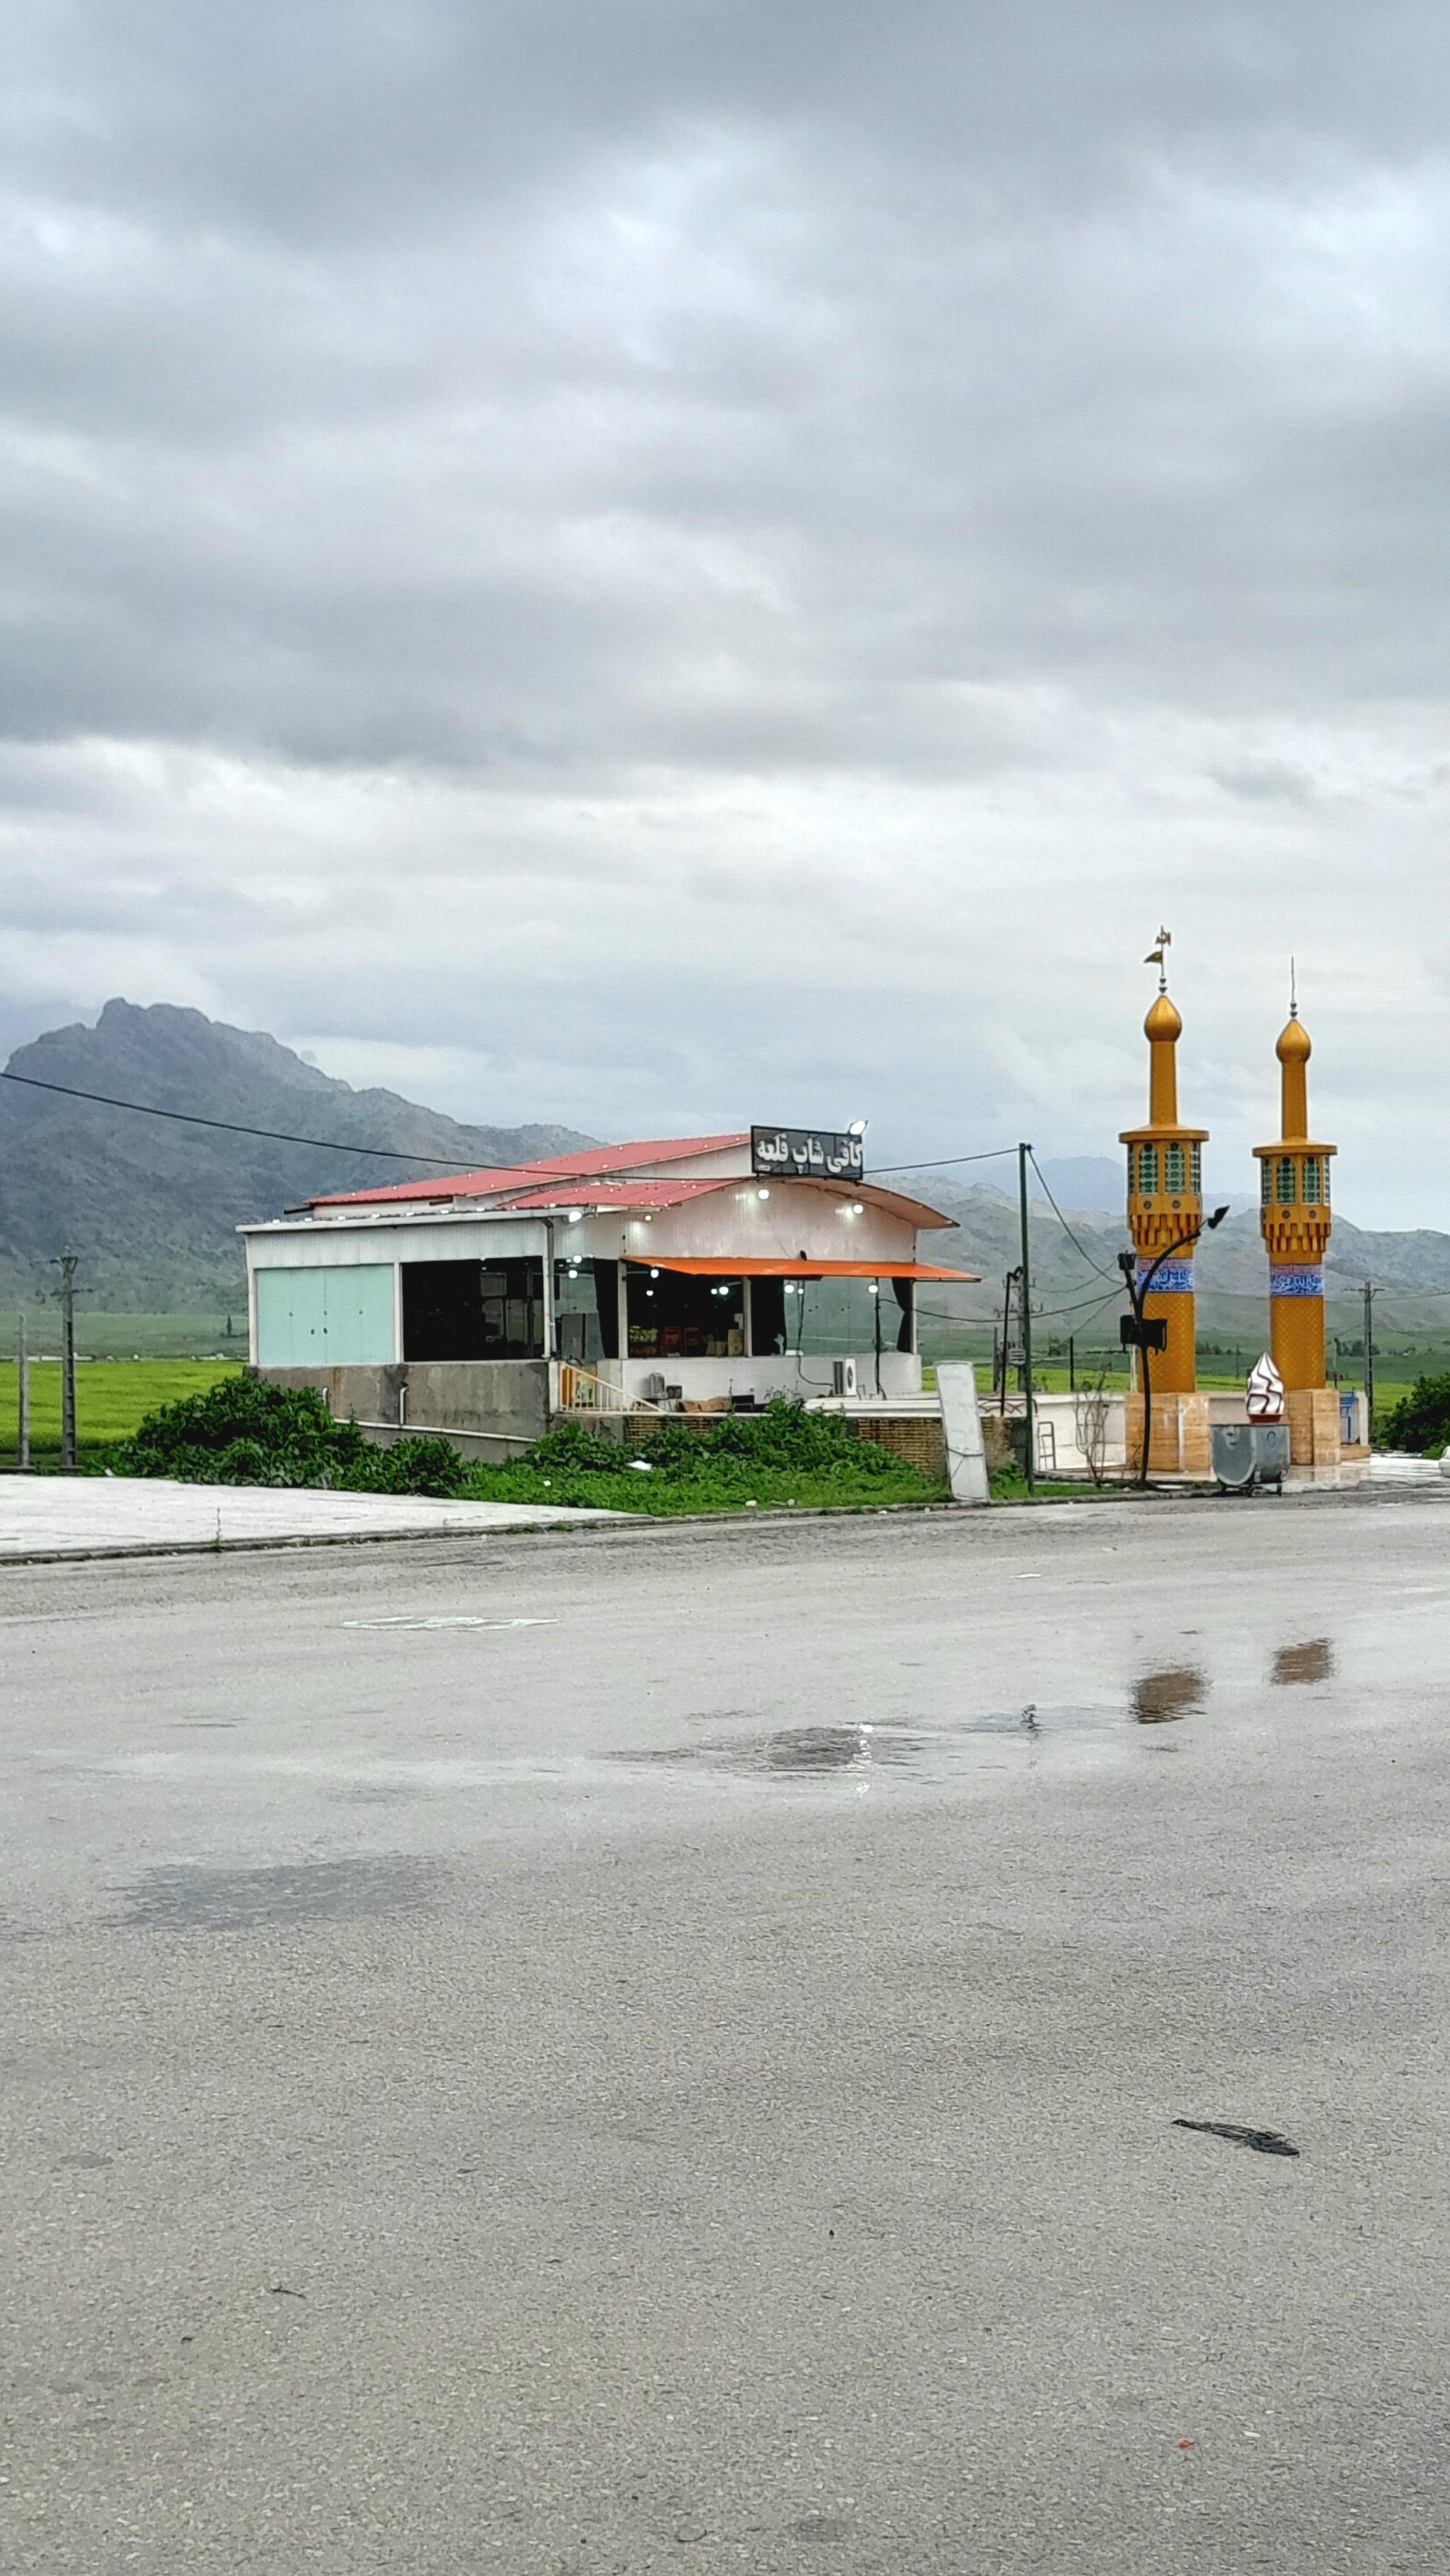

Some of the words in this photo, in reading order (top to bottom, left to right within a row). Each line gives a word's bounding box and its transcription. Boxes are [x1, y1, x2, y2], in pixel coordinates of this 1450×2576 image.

[757, 1133, 789, 1162] قلعه
[791, 1138, 824, 1174] شاپ
[826, 1140, 862, 1173] کافی
